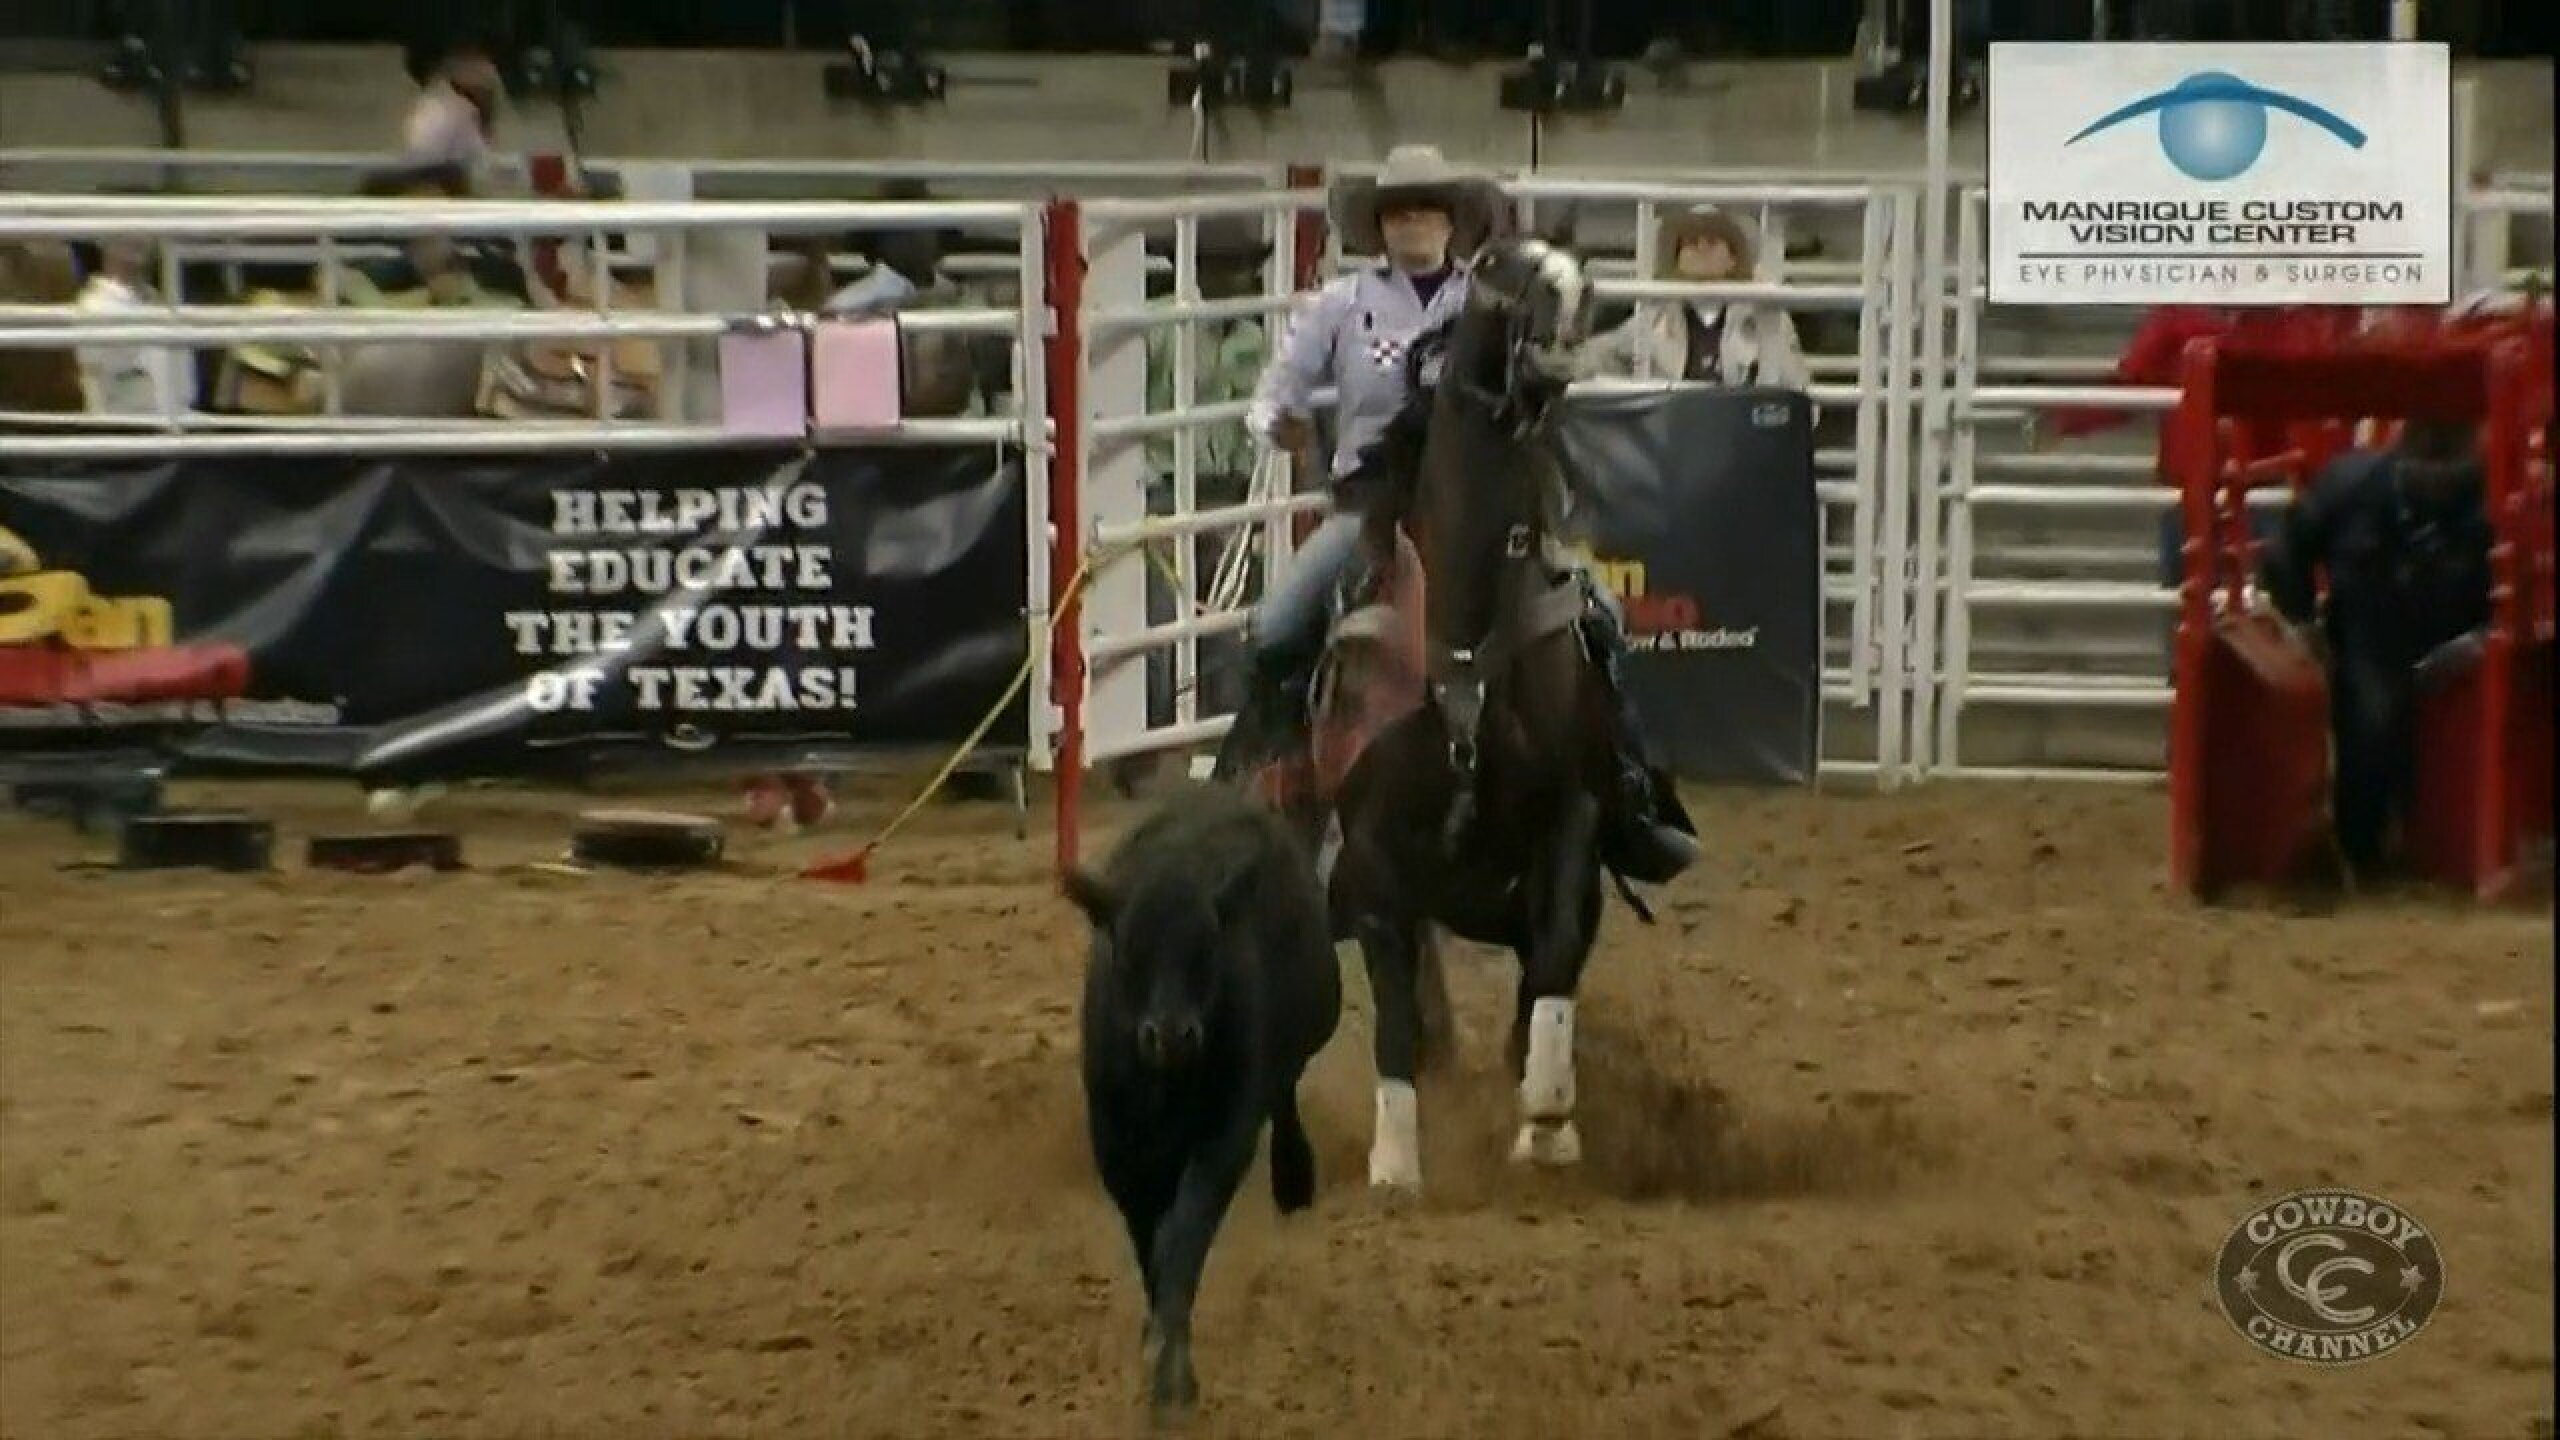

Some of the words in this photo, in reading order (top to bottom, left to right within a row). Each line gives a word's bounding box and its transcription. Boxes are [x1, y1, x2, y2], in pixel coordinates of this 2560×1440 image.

[550, 482, 829, 535] HELPING
[545, 544, 833, 594] EDUCATE
[503, 610, 636, 654] THE
[660, 604, 876, 651] YOUTH
[525, 671, 606, 713] OF
[627, 666, 859, 711] TEXAS!
